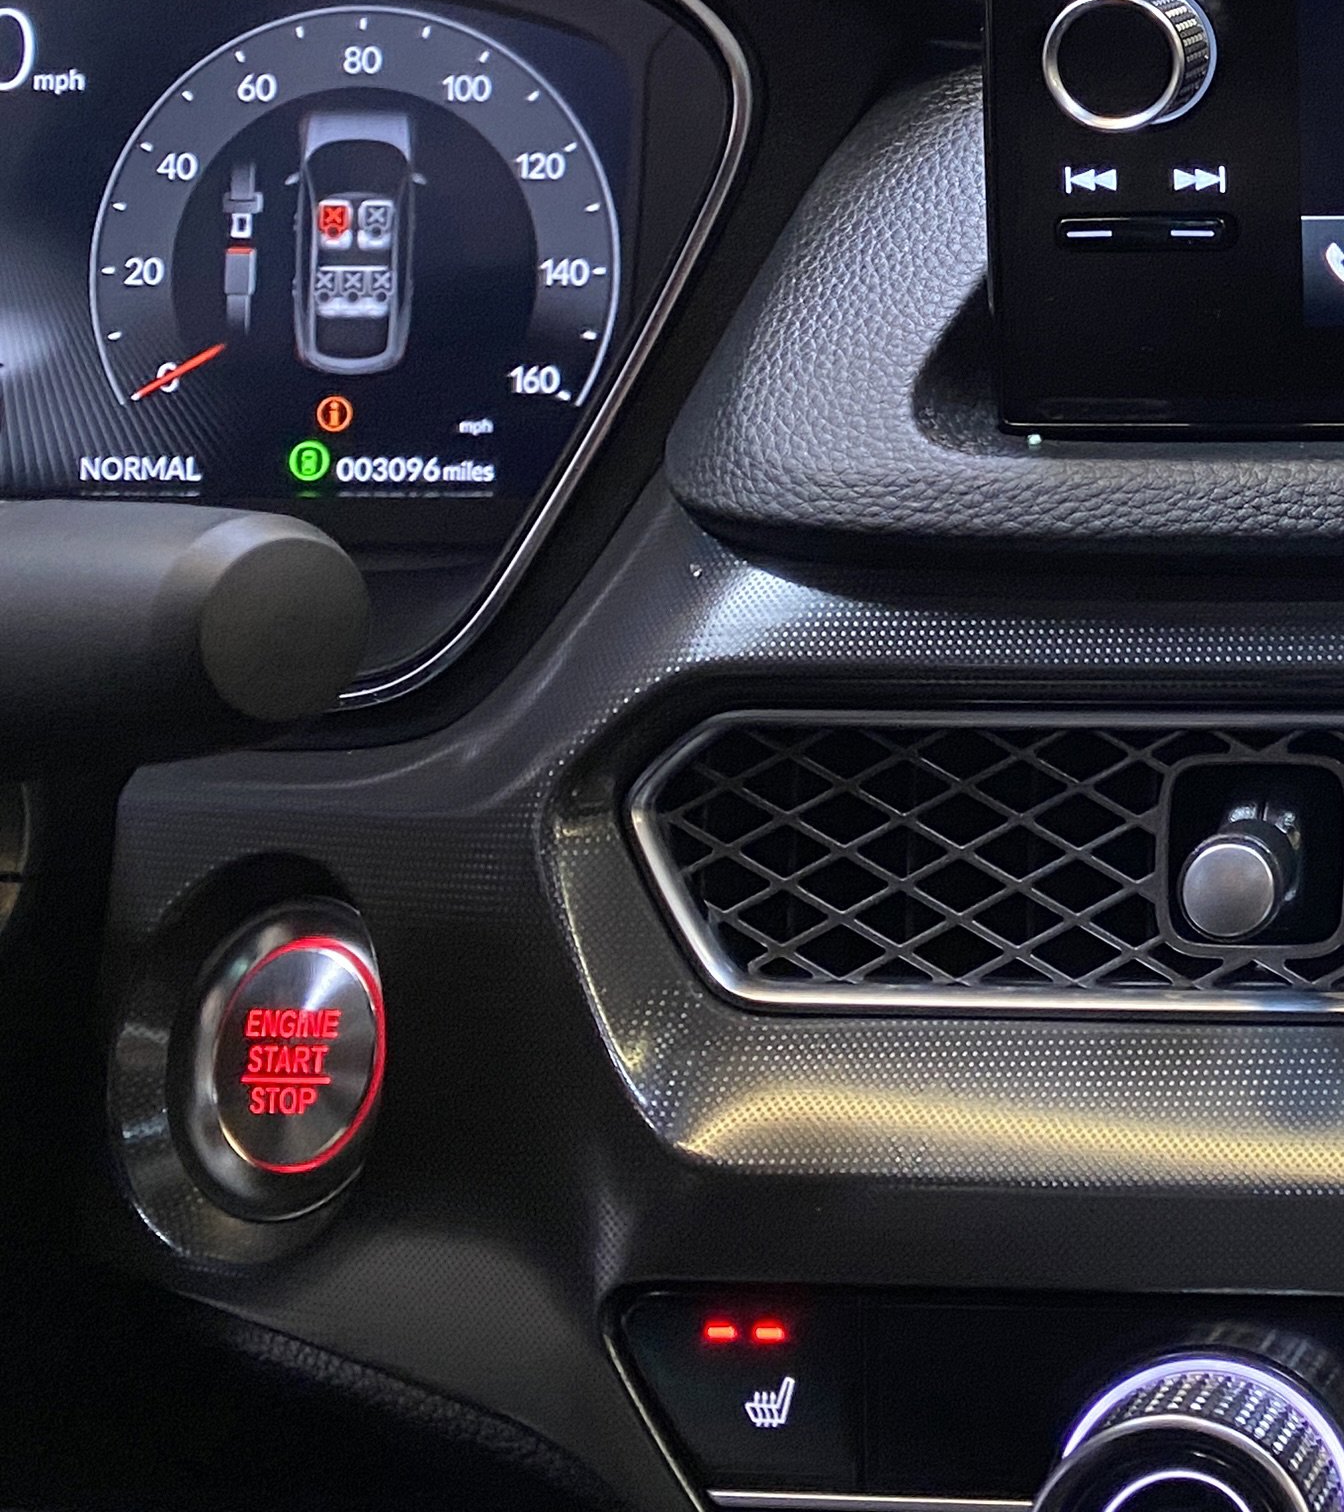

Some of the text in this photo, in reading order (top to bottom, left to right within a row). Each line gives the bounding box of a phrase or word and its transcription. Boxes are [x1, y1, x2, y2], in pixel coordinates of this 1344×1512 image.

[343, 45, 383, 74] 80
[33, 68, 86, 95] mph
[237, 73, 278, 102] 60
[442, 74, 493, 102] 100
[156, 152, 199, 181] 40
[515, 152, 566, 180] 120
[123, 256, 165, 286] 20
[539, 258, 591, 287] 140
[507, 365, 561, 394] 160
[458, 418, 494, 436] mph
[79, 455, 202, 482] NORMAL
[335, 456, 495, 483] 003096 miles
[246, 1009, 342, 1038] ENGINE
[247, 1044, 330, 1074] START
[249, 1087, 318, 1115] STOP
